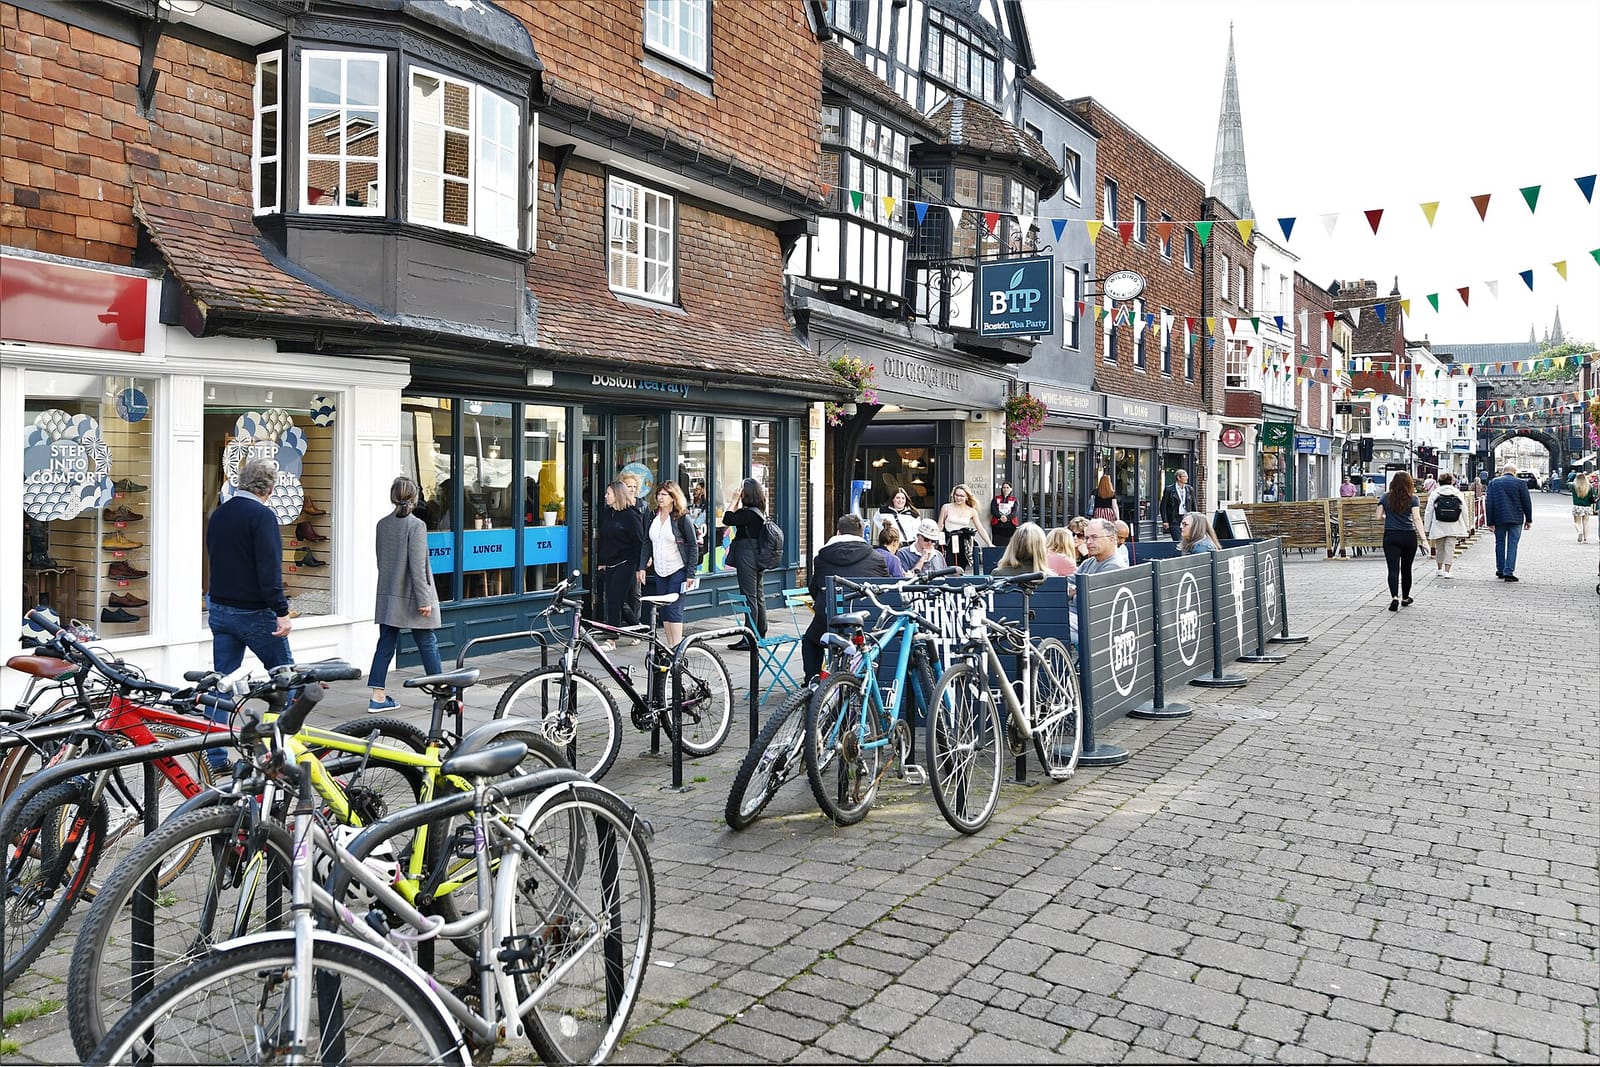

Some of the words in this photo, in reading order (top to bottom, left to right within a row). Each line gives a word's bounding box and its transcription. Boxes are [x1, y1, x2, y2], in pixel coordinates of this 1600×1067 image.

[1110, 273, 1139, 283] WILDING
[989, 288, 1041, 315] BTP
[1010, 320, 1025, 329] Tea
[1025, 319, 1047, 329] Party
[883, 356, 905, 379] OLD
[1122, 403, 1149, 418] WILDING
[51, 445, 86, 457] STEP
[247, 446, 279, 458] STEP
[49, 458, 86, 470] INTO
[31, 471, 105, 483] COMFORT
[473, 544, 503, 554] LUNCH
[536, 540, 552, 549] TEA
[428, 547, 451, 557] FAST
[1179, 610, 1199, 644] BTP
[1113, 630, 1136, 672] BTP
